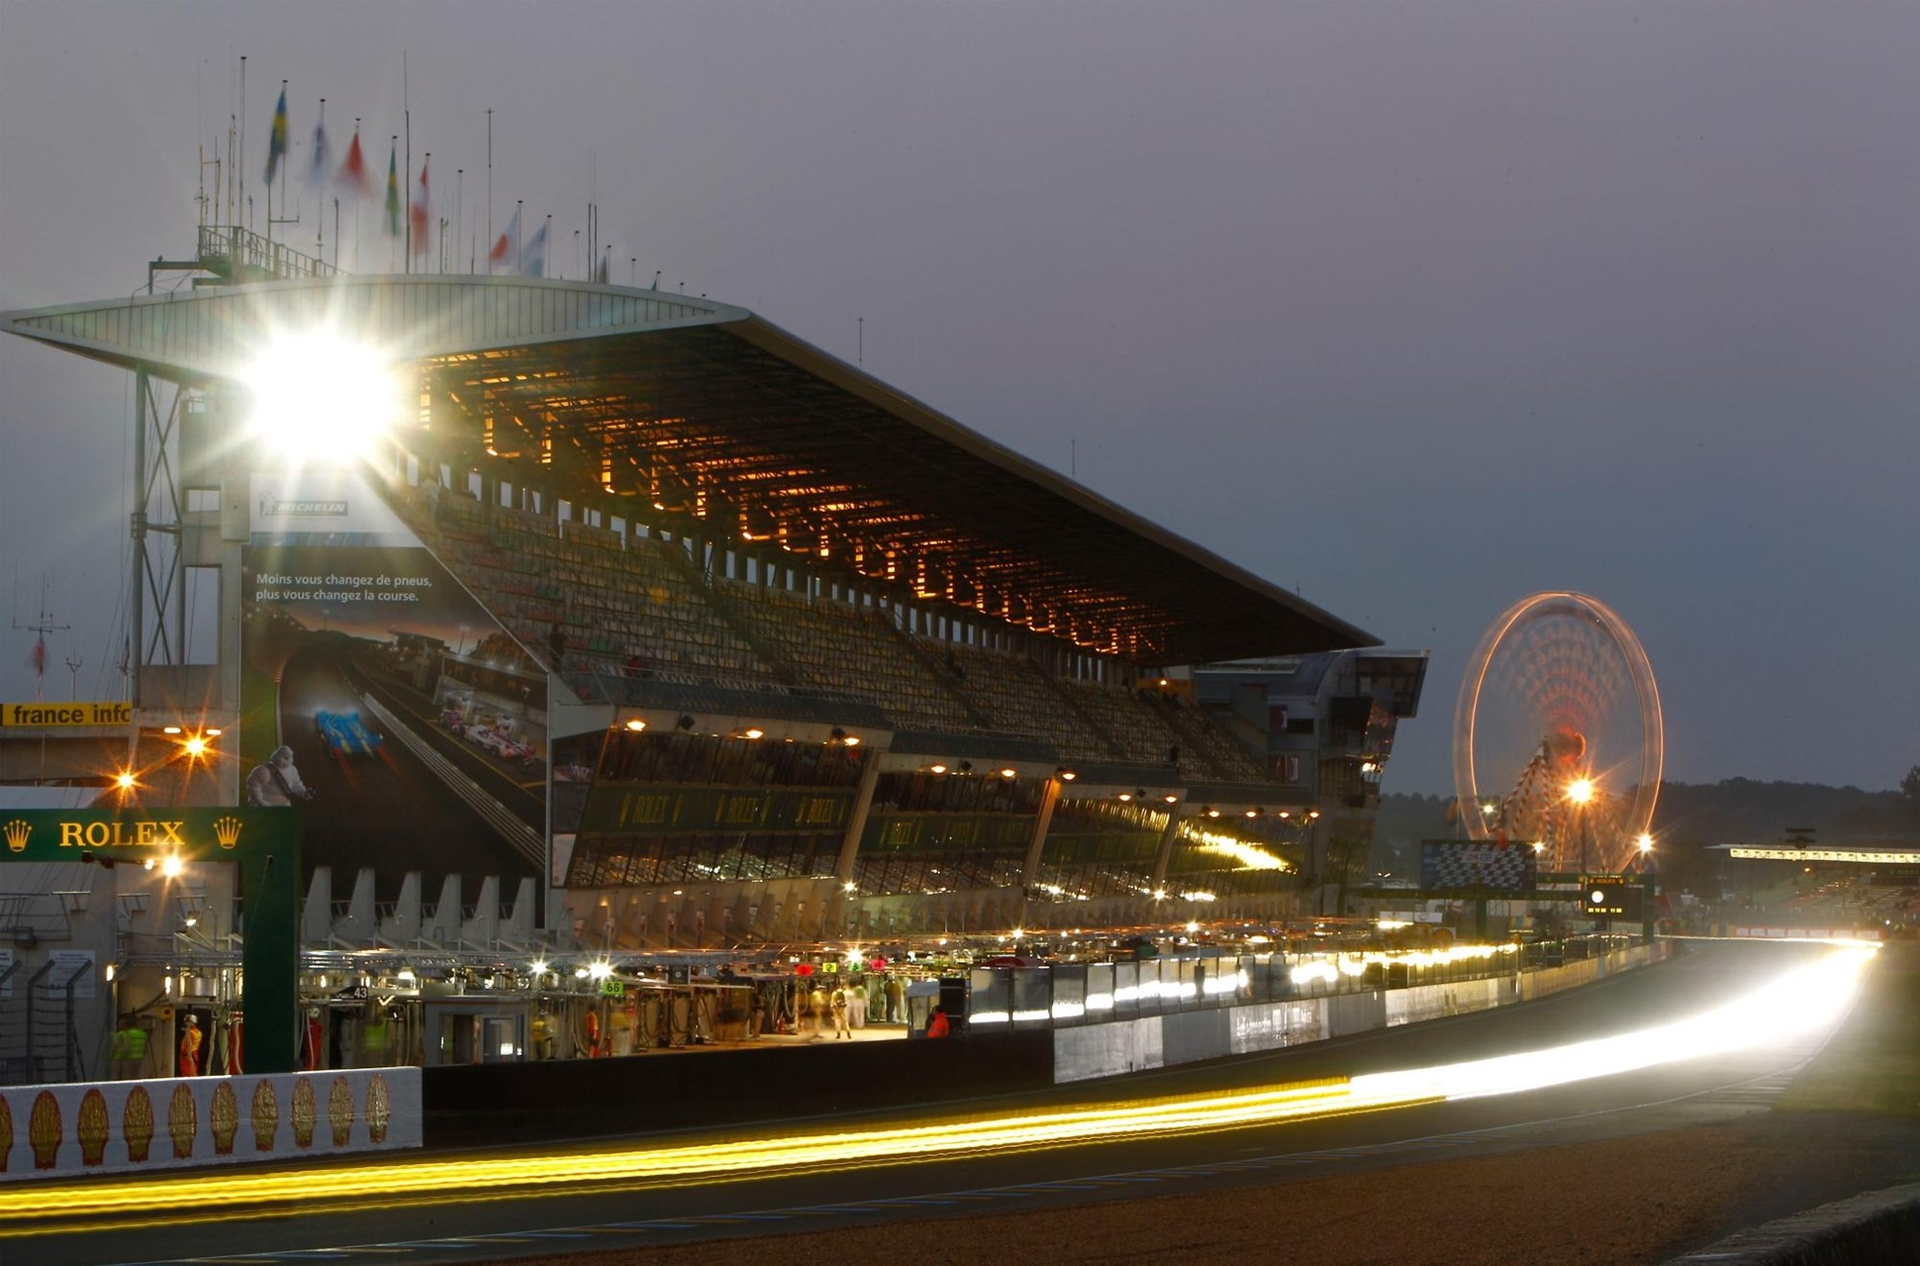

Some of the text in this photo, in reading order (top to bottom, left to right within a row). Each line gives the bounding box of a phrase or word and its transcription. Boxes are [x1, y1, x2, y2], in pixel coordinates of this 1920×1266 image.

[277, 503, 346, 512] MICHELIN
[256, 573, 432, 588] Moins vous changez de pneus,
[256, 589, 419, 603] plus vous changez la course.
[14, 705, 84, 723] france
[59, 821, 185, 846] ROLEX
[354, 987, 367, 999] 43
[606, 982, 620, 993] 66
